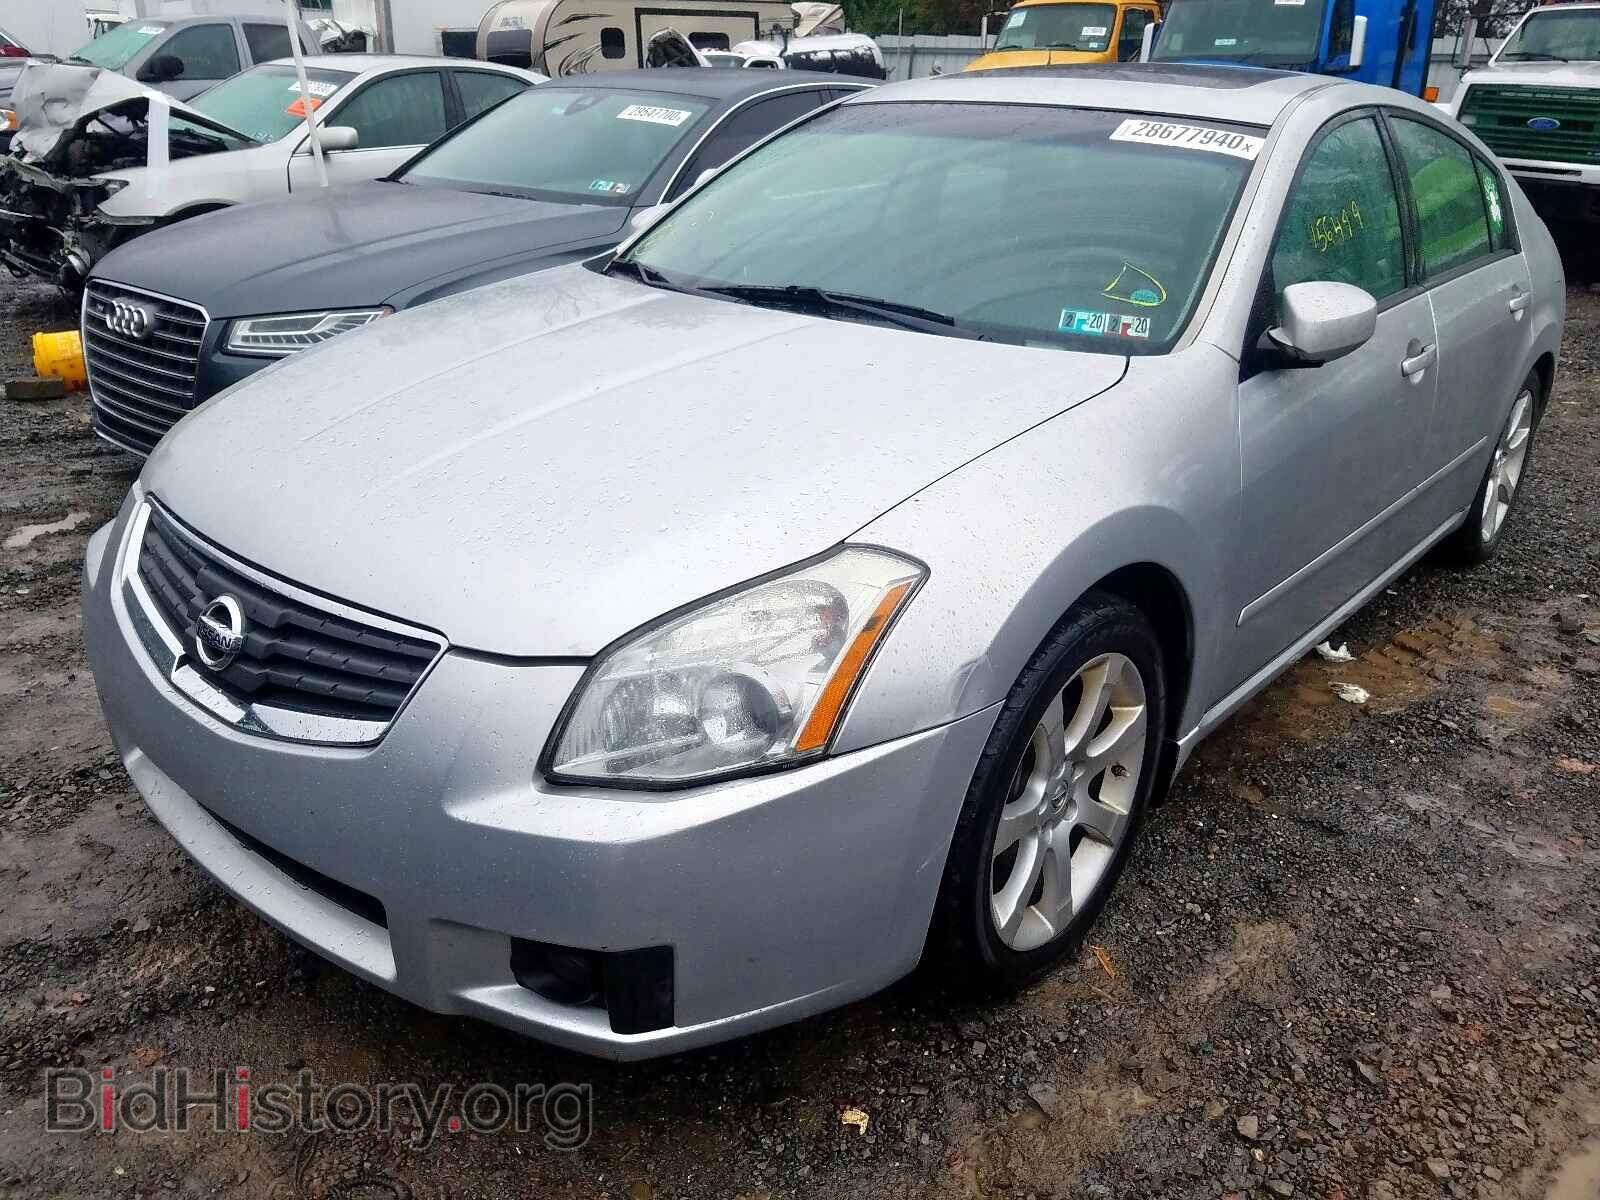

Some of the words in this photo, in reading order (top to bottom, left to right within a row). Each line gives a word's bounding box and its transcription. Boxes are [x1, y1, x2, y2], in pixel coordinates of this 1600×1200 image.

[1063, 314, 1073, 325] 2
[1089, 313, 1103, 329] 20
[1134, 319, 1148, 333] 20
